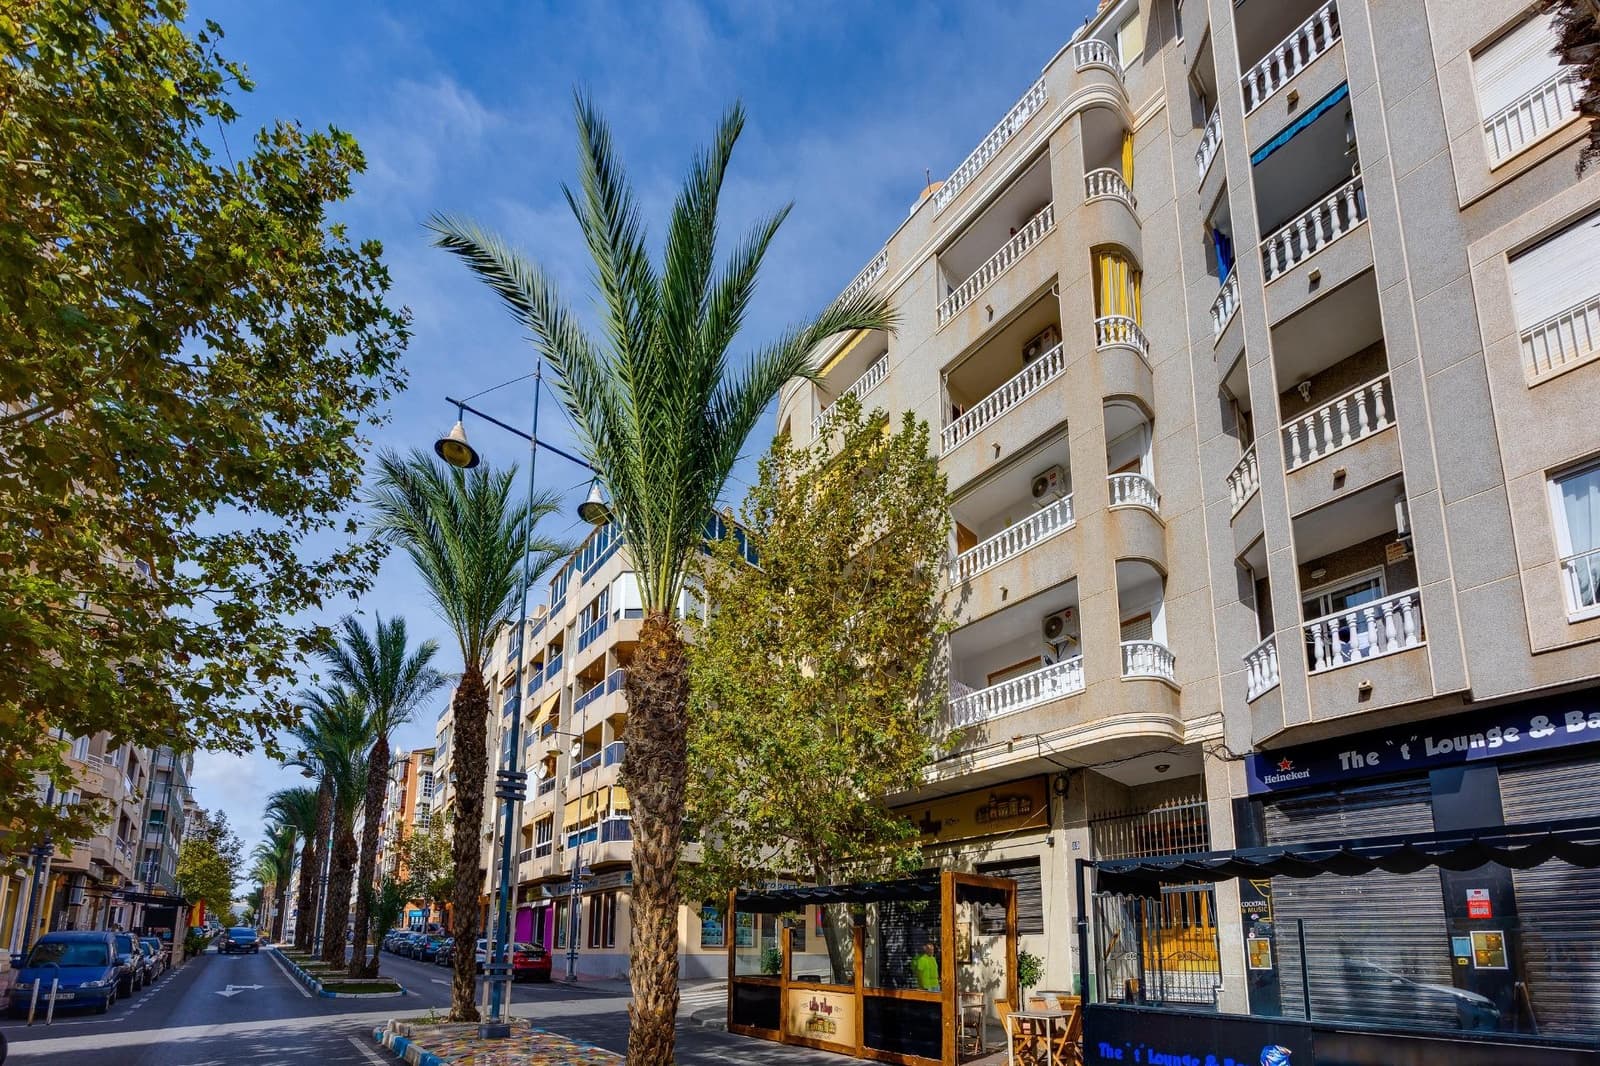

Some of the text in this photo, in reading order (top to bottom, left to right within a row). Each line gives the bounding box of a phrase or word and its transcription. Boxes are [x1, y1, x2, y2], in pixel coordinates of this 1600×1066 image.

[1338, 750, 1380, 771] The
[1424, 726, 1520, 757] Lounge
[1528, 715, 1557, 738] &
[1264, 768, 1310, 785] Heineken
[1099, 1042, 1122, 1060] The
